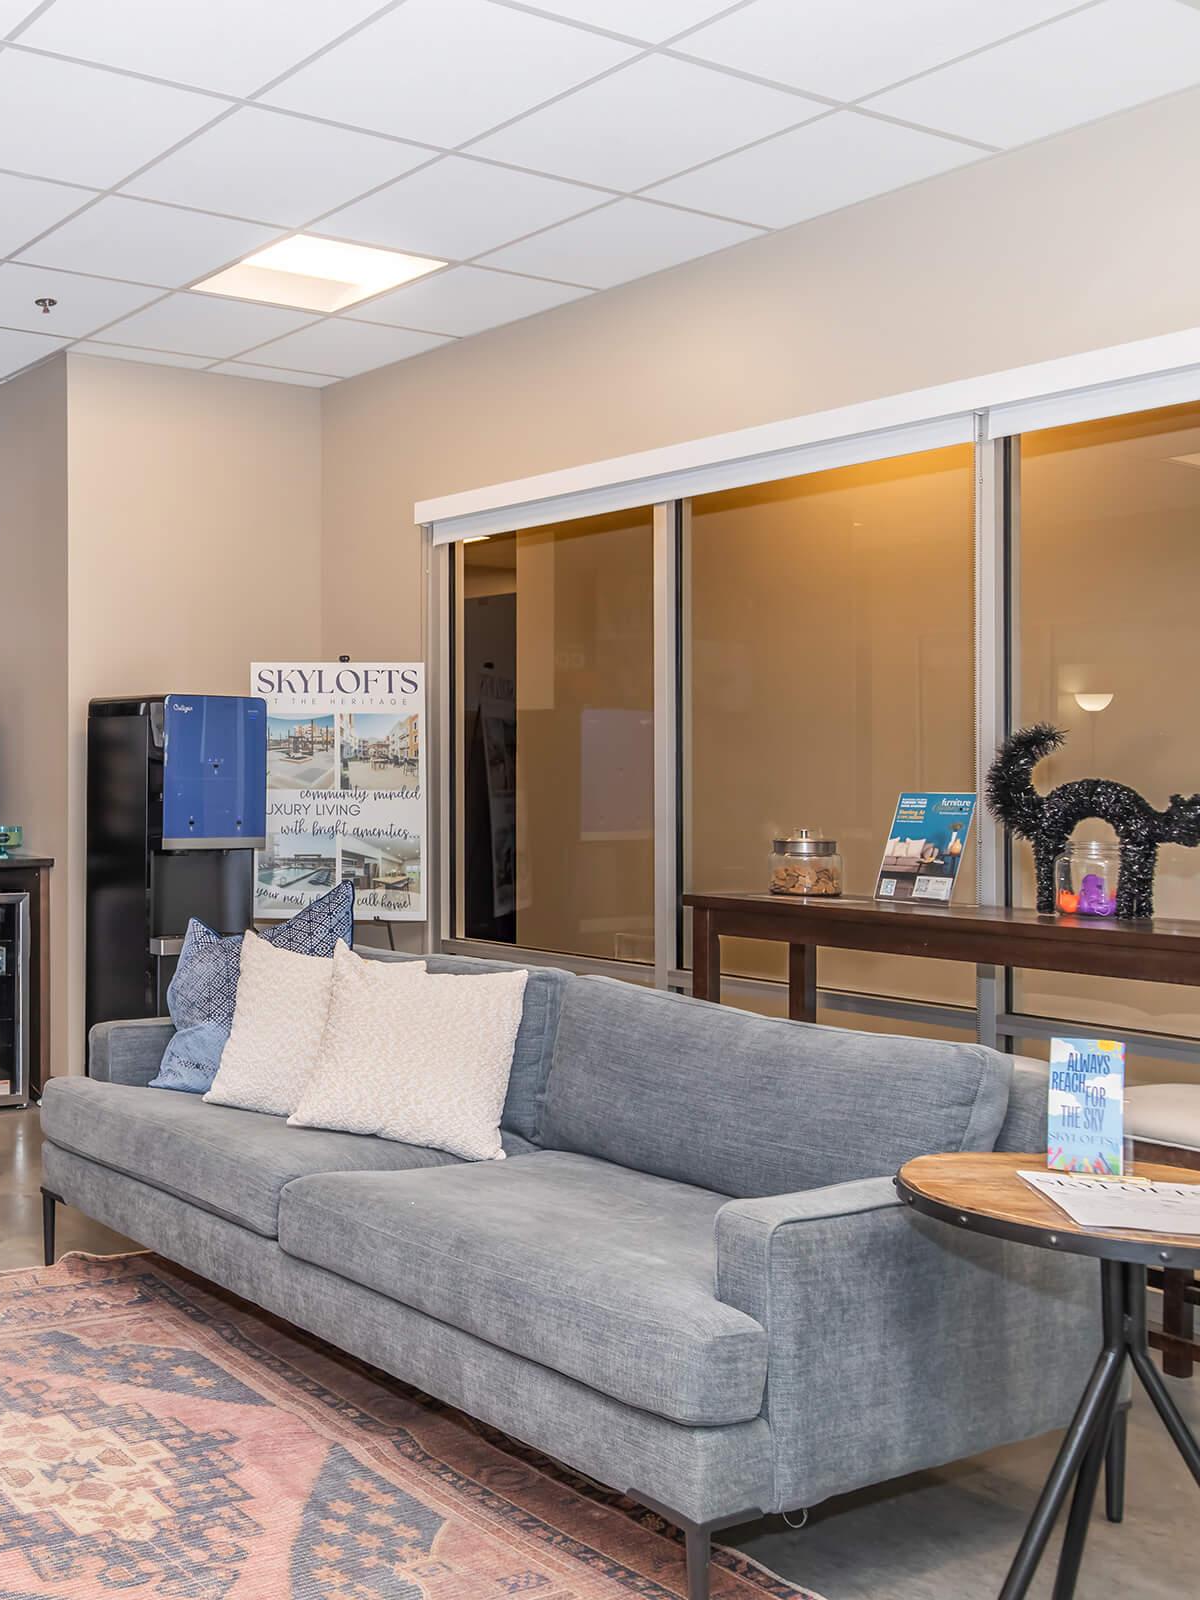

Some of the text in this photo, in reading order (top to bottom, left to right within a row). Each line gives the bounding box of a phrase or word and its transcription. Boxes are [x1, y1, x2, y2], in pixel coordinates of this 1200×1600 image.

[256, 669, 419, 694] SKYLOFTS
[330, 698, 408, 706] HERITAGE
[300, 784, 421, 804] community minded
[266, 803, 361, 817] UXURY LIVING
[280, 818, 308, 835] with
[312, 819, 348, 840] bright
[255, 886, 280, 898] your
[283, 894, 306, 906] next
[356, 893, 380, 906] call
[380, 893, 412, 909] home!
[1067, 1053, 1111, 1075] ALWAYS
[1052, 1071, 1086, 1093] REACH
[1085, 1086, 1106, 1108] FOR
[1060, 1104, 1105, 1133] THE SKY
